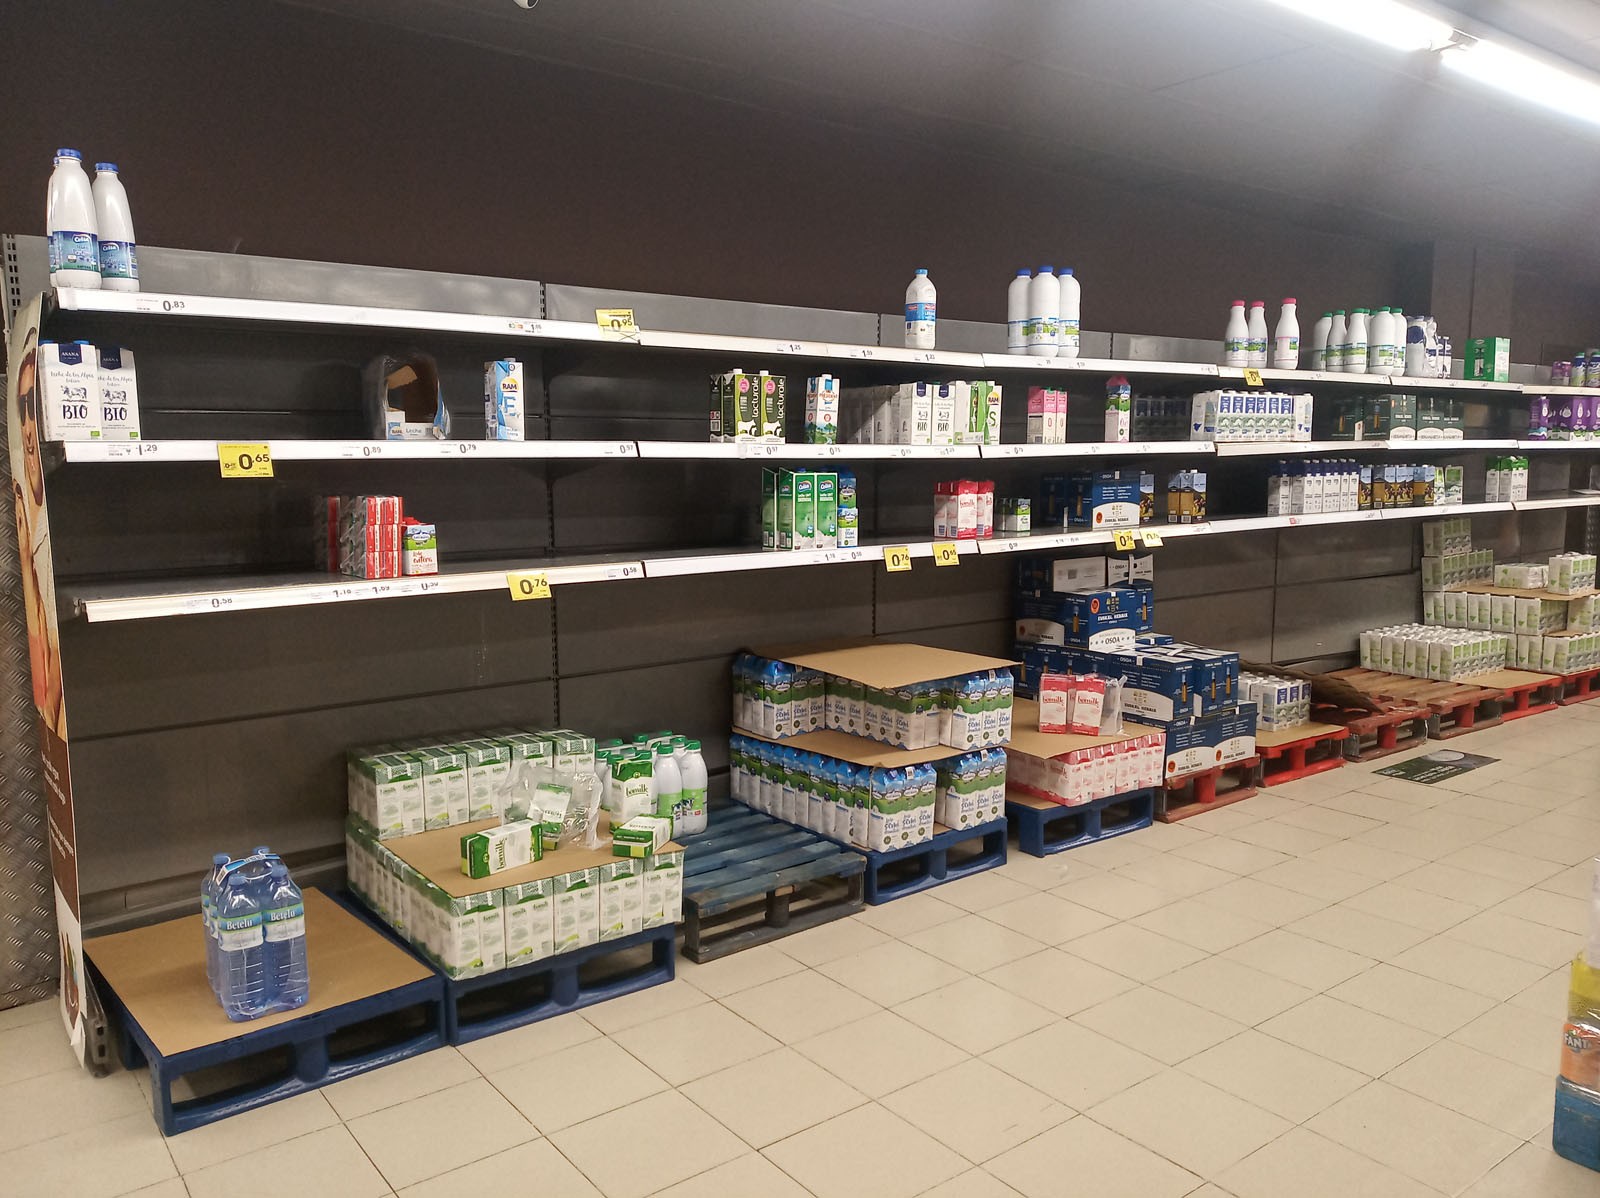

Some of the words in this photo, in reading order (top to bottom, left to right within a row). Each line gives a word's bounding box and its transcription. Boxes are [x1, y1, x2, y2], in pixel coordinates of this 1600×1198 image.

[62, 403, 88, 420] BIO
[103, 406, 128, 422] BIO
[917, 422, 928, 432] BIO
[938, 422, 949, 432] BIO
[1105, 636, 1121, 645] OSOA
[1042, 694, 1065, 705] bomilk
[1077, 695, 1100, 706] bomilk
[625, 783, 649, 798] bomilk
[494, 838, 506, 871] bomilk
